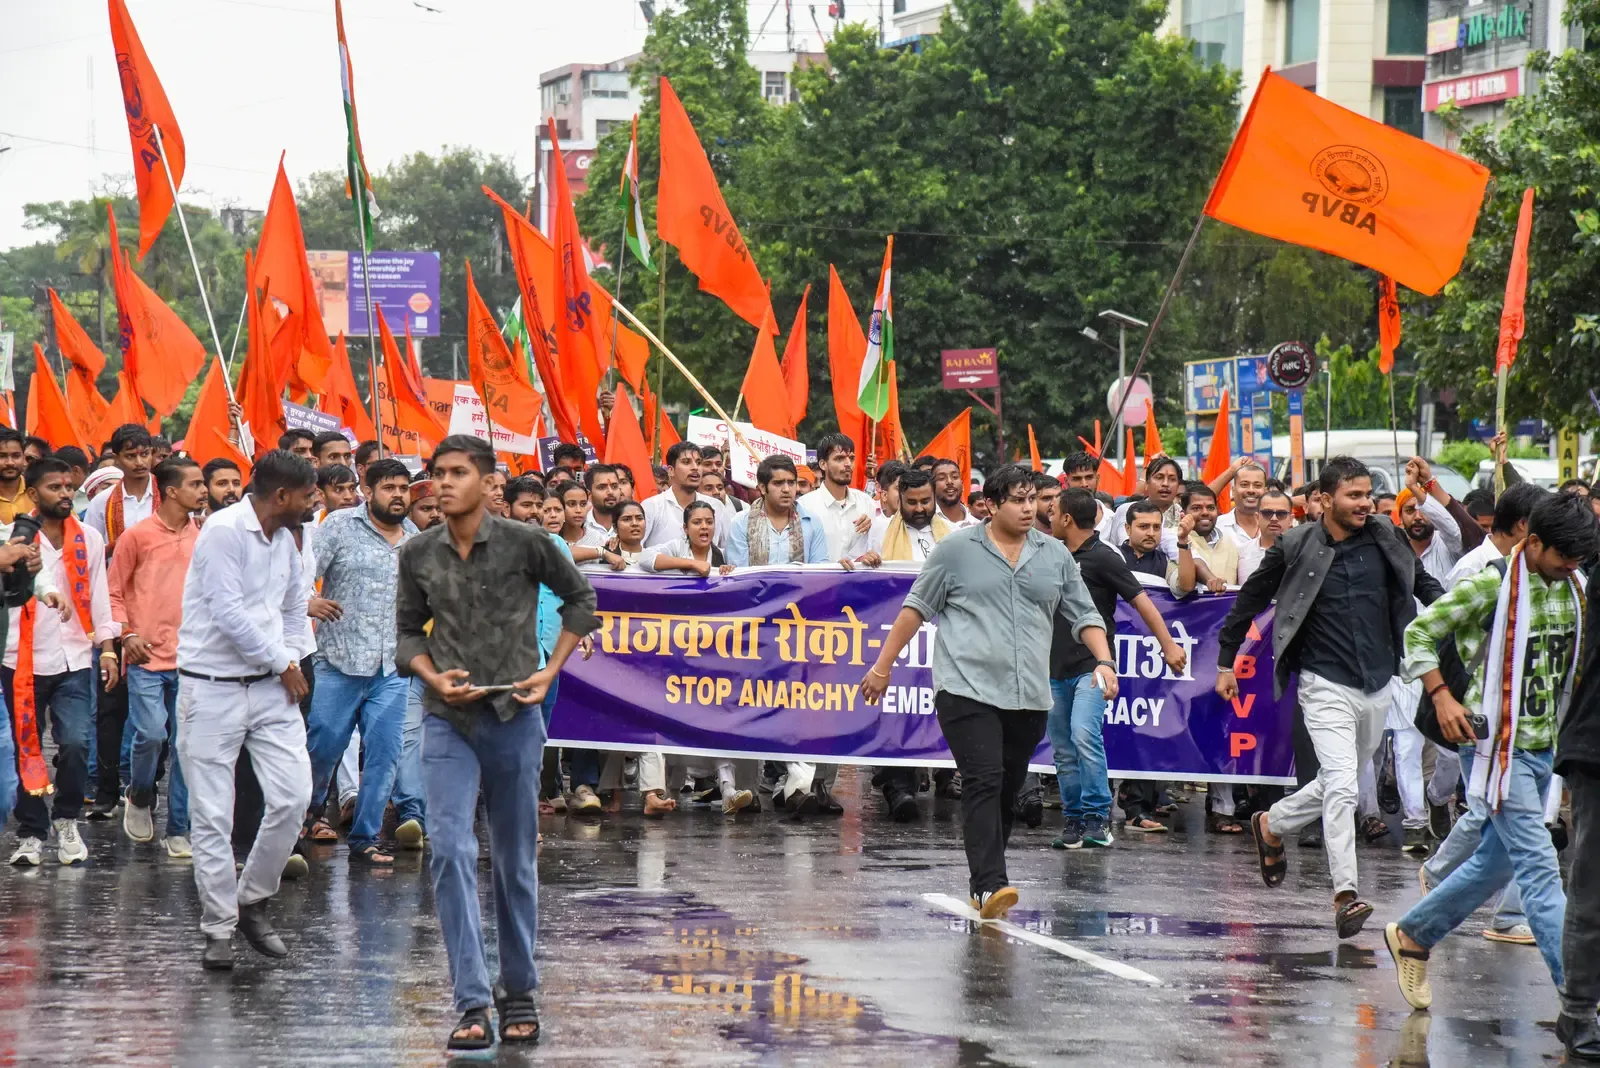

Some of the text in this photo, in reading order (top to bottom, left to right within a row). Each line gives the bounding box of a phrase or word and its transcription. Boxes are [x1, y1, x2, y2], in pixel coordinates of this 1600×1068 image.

[353, 257, 371, 266] Brig
[361, 265, 396, 273] wnership
[74, 534, 87, 593] ABVP
[578, 611, 766, 660] राजकता
[665, 675, 732, 705] STOP
[738, 679, 860, 712] ANARCHY
[1103, 696, 1165, 727] RACY
